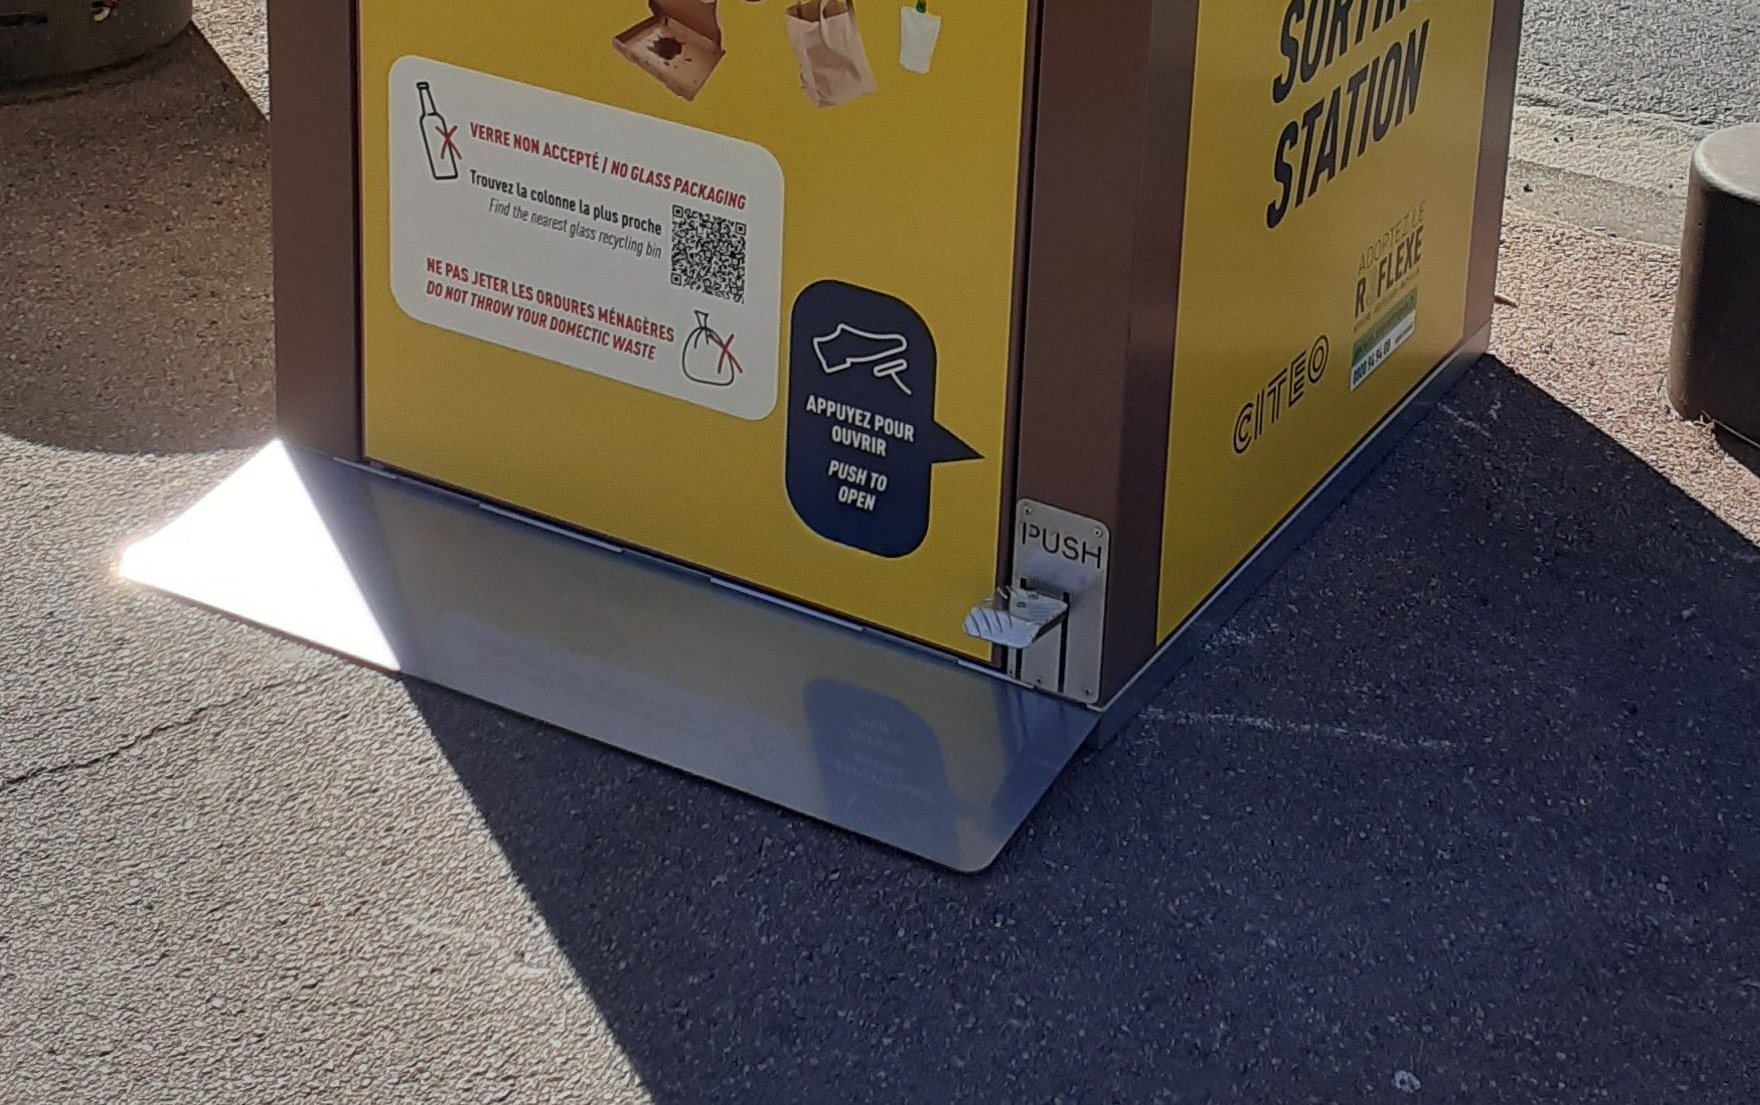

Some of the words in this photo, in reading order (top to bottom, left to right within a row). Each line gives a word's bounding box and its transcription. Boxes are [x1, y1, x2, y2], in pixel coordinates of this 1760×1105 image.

[1266, 19, 1430, 229] STATION
[470, 122, 511, 147] VERRE
[513, 134, 540, 154] NON
[543, 143, 600, 170] ACCEPTÉ
[610, 160, 629, 178] NO
[630, 166, 672, 190] GLASS
[673, 177, 747, 210] PACKAGING
[470, 169, 514, 195] Trouvez
[516, 182, 528, 199] la
[530, 188, 576, 212] colonne
[579, 199, 590, 216] la
[593, 205, 619, 223] plus
[621, 213, 662, 236] proche
[489, 197, 511, 217] Find
[512, 205, 529, 222] the
[530, 212, 568, 233] nearest
[569, 222, 597, 241] glass
[599, 230, 644, 258] recycling
[645, 244, 662, 260] bin
[426, 257, 443, 275] NE
[445, 263, 469, 283] PAS
[471, 271, 508, 295] JETER
[511, 282, 534, 301] LES
[536, 289, 595, 319] ORDURES
[598, 306, 674, 342] MÉNAGÈRES
[1355, 225, 1424, 318] RFLEXE
[426, 280, 443, 297] DO
[444, 286, 469, 304] NOT
[471, 291, 515, 317] THROW
[516, 306, 547, 328] YOUR
[549, 316, 610, 346] DOMECTIC
[612, 334, 656, 360] WASTE
[806, 395, 872, 429] APPUYEZ
[874, 414, 915, 443] POUR
[1233, 334, 1330, 454] CITEO
[831, 425, 887, 457] OUVRIR
[828, 460, 868, 486] PUSH
[871, 471, 888, 492] TO
[838, 485, 876, 511] OPEN
[1021, 521, 1102, 569] PUSH
